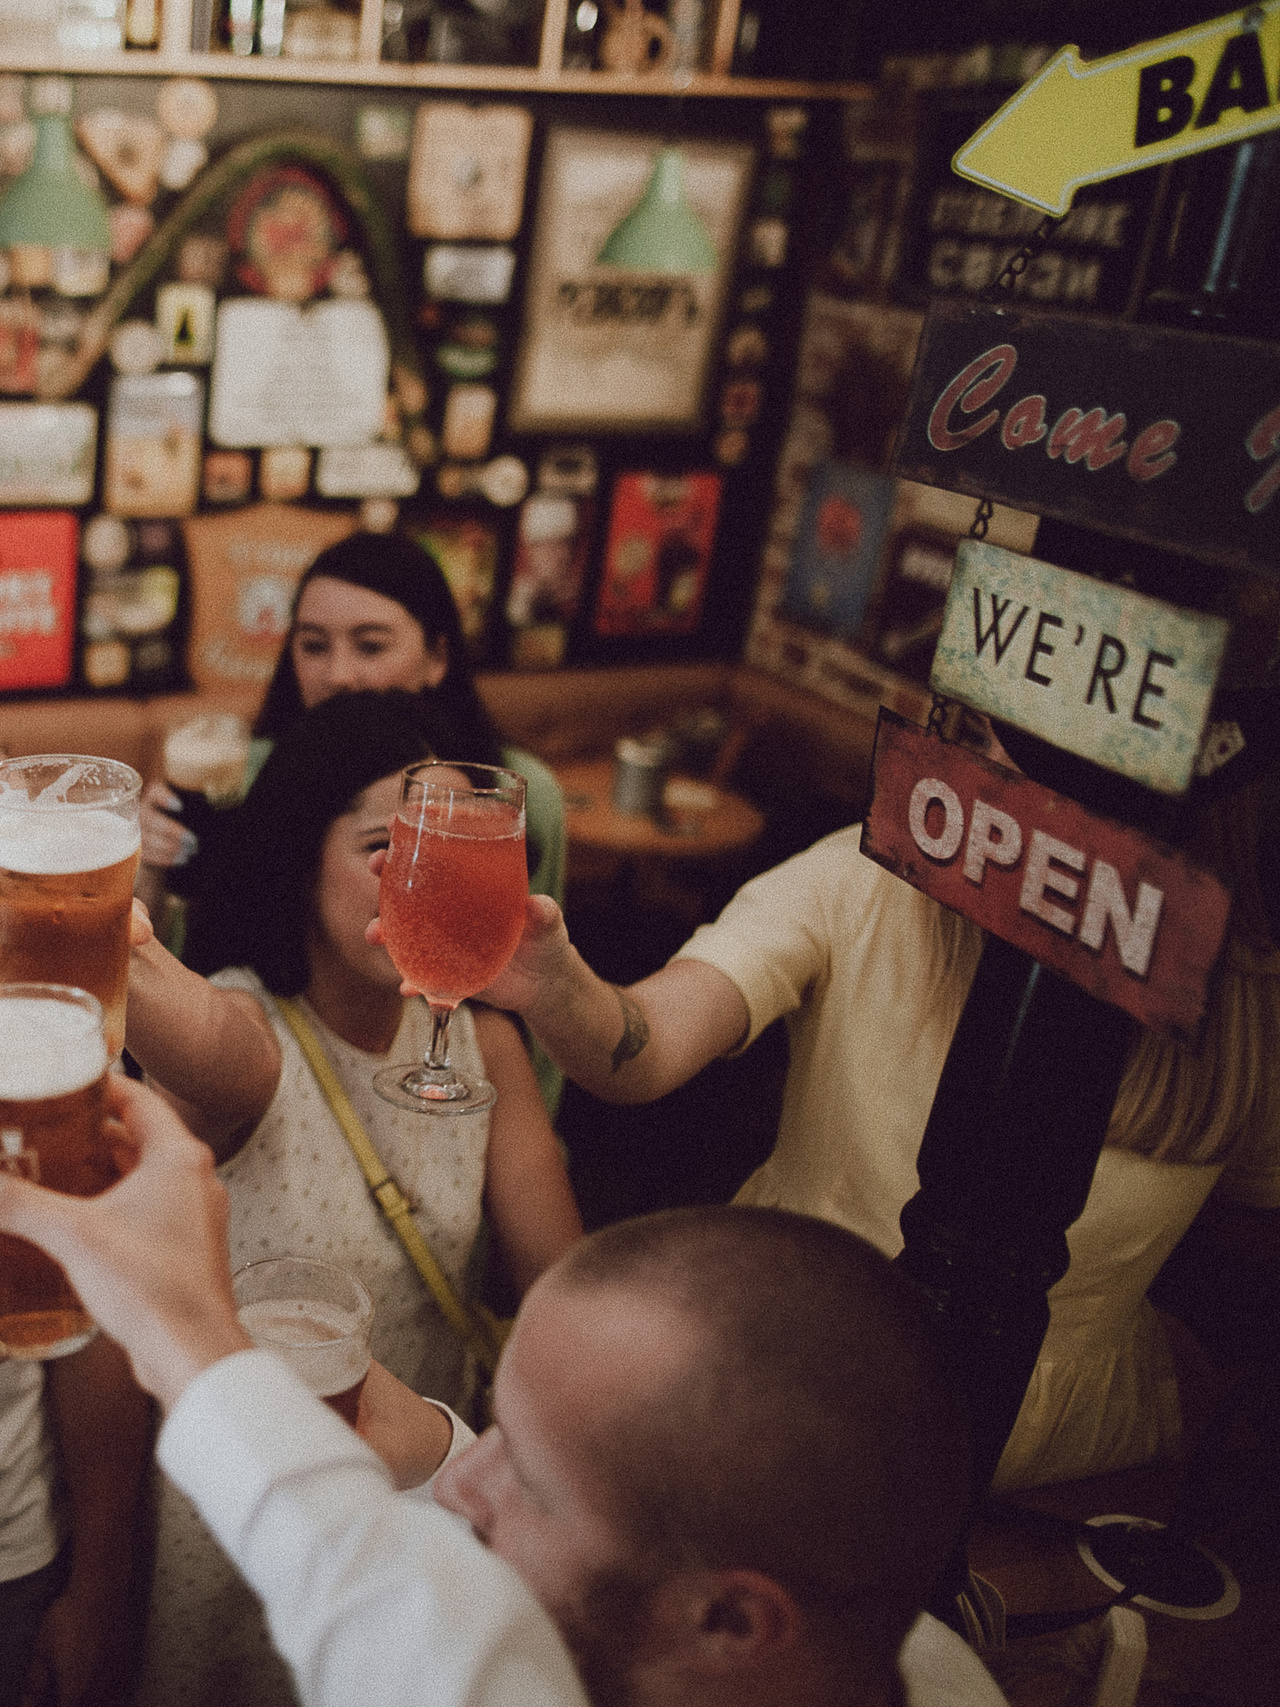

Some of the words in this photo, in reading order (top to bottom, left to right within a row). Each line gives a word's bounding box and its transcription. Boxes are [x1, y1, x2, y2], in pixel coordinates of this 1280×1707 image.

[1134, 31, 1280, 148] BA
[928, 344, 1181, 482] Come
[973, 587, 1176, 731] WE'RE
[908, 777, 1165, 977] OPEN
